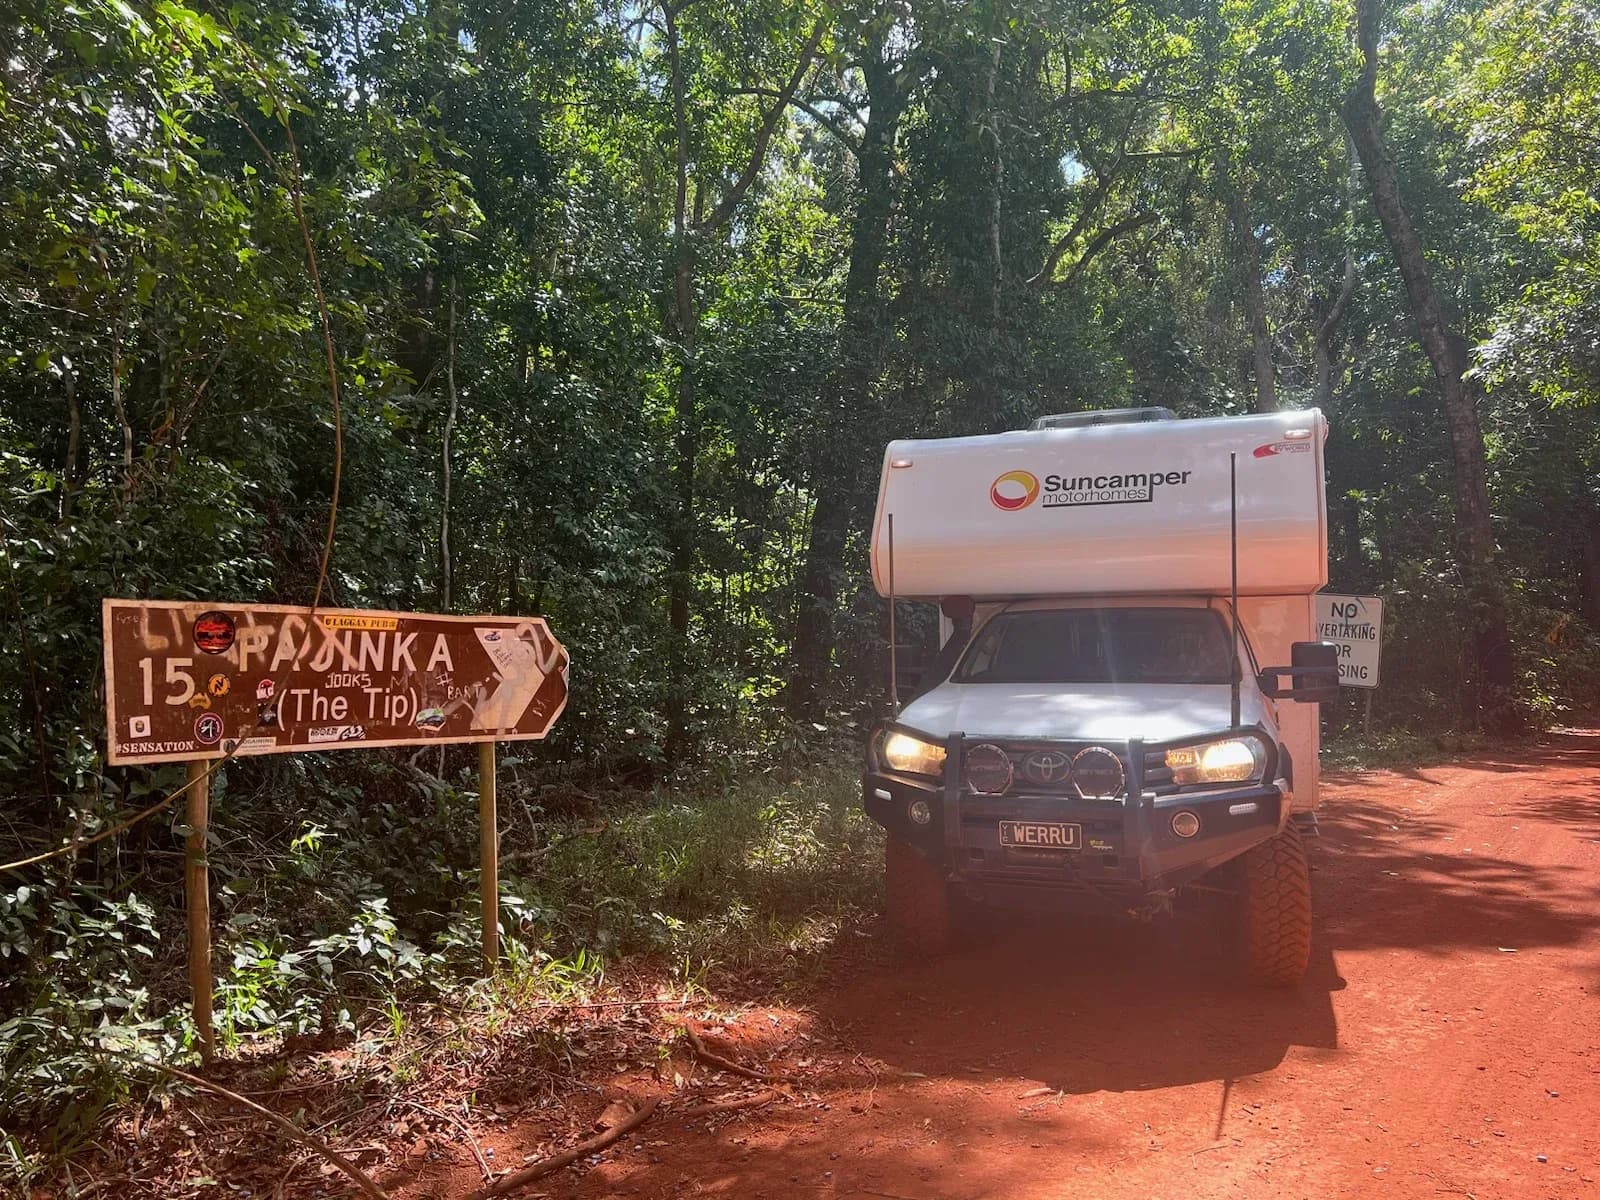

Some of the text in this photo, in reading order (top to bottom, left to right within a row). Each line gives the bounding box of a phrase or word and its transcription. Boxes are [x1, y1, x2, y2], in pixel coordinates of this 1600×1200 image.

[1044, 471, 1192, 498] Suncamper
[1043, 488, 1148, 503] motorhomes
[1331, 602, 1358, 618] NO
[1316, 623, 1376, 640] VERTAKING
[239, 628, 454, 673] PAJINKA
[138, 657, 196, 706] 15
[1338, 664, 1368, 679] SING
[277, 688, 348, 732] (The
[363, 687, 418, 726] Tip)
[1013, 825, 1074, 845] WERRU
